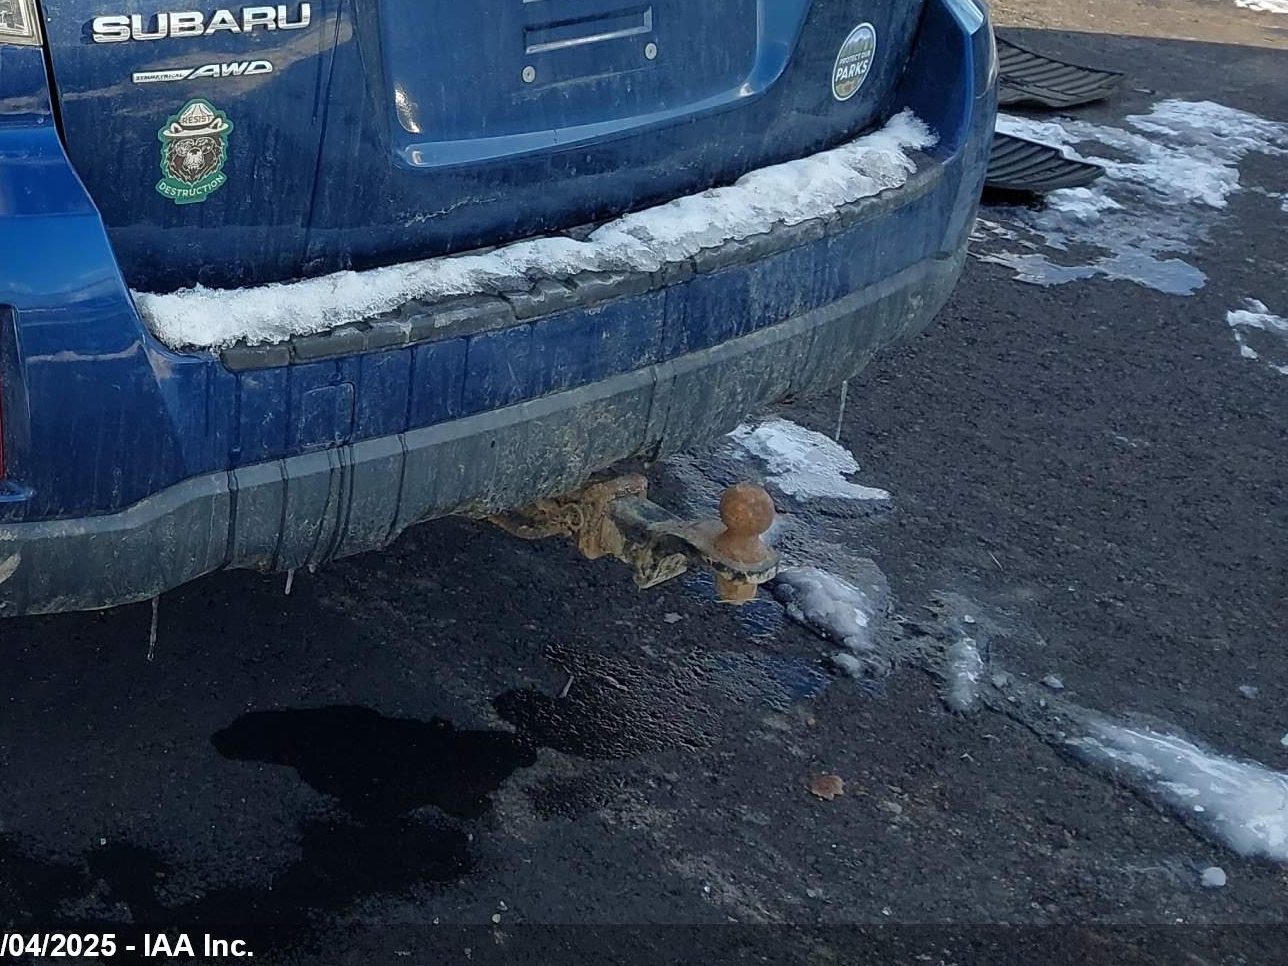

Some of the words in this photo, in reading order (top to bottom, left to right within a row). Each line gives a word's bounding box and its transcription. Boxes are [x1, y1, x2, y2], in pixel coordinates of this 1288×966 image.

[93, 3, 311, 43] SUBARU
[187, 60, 273, 80] AWD
[835, 59, 869, 82] PARKS
[182, 115, 212, 124] RESIST
[158, 174, 225, 197] DESTRUCTION
